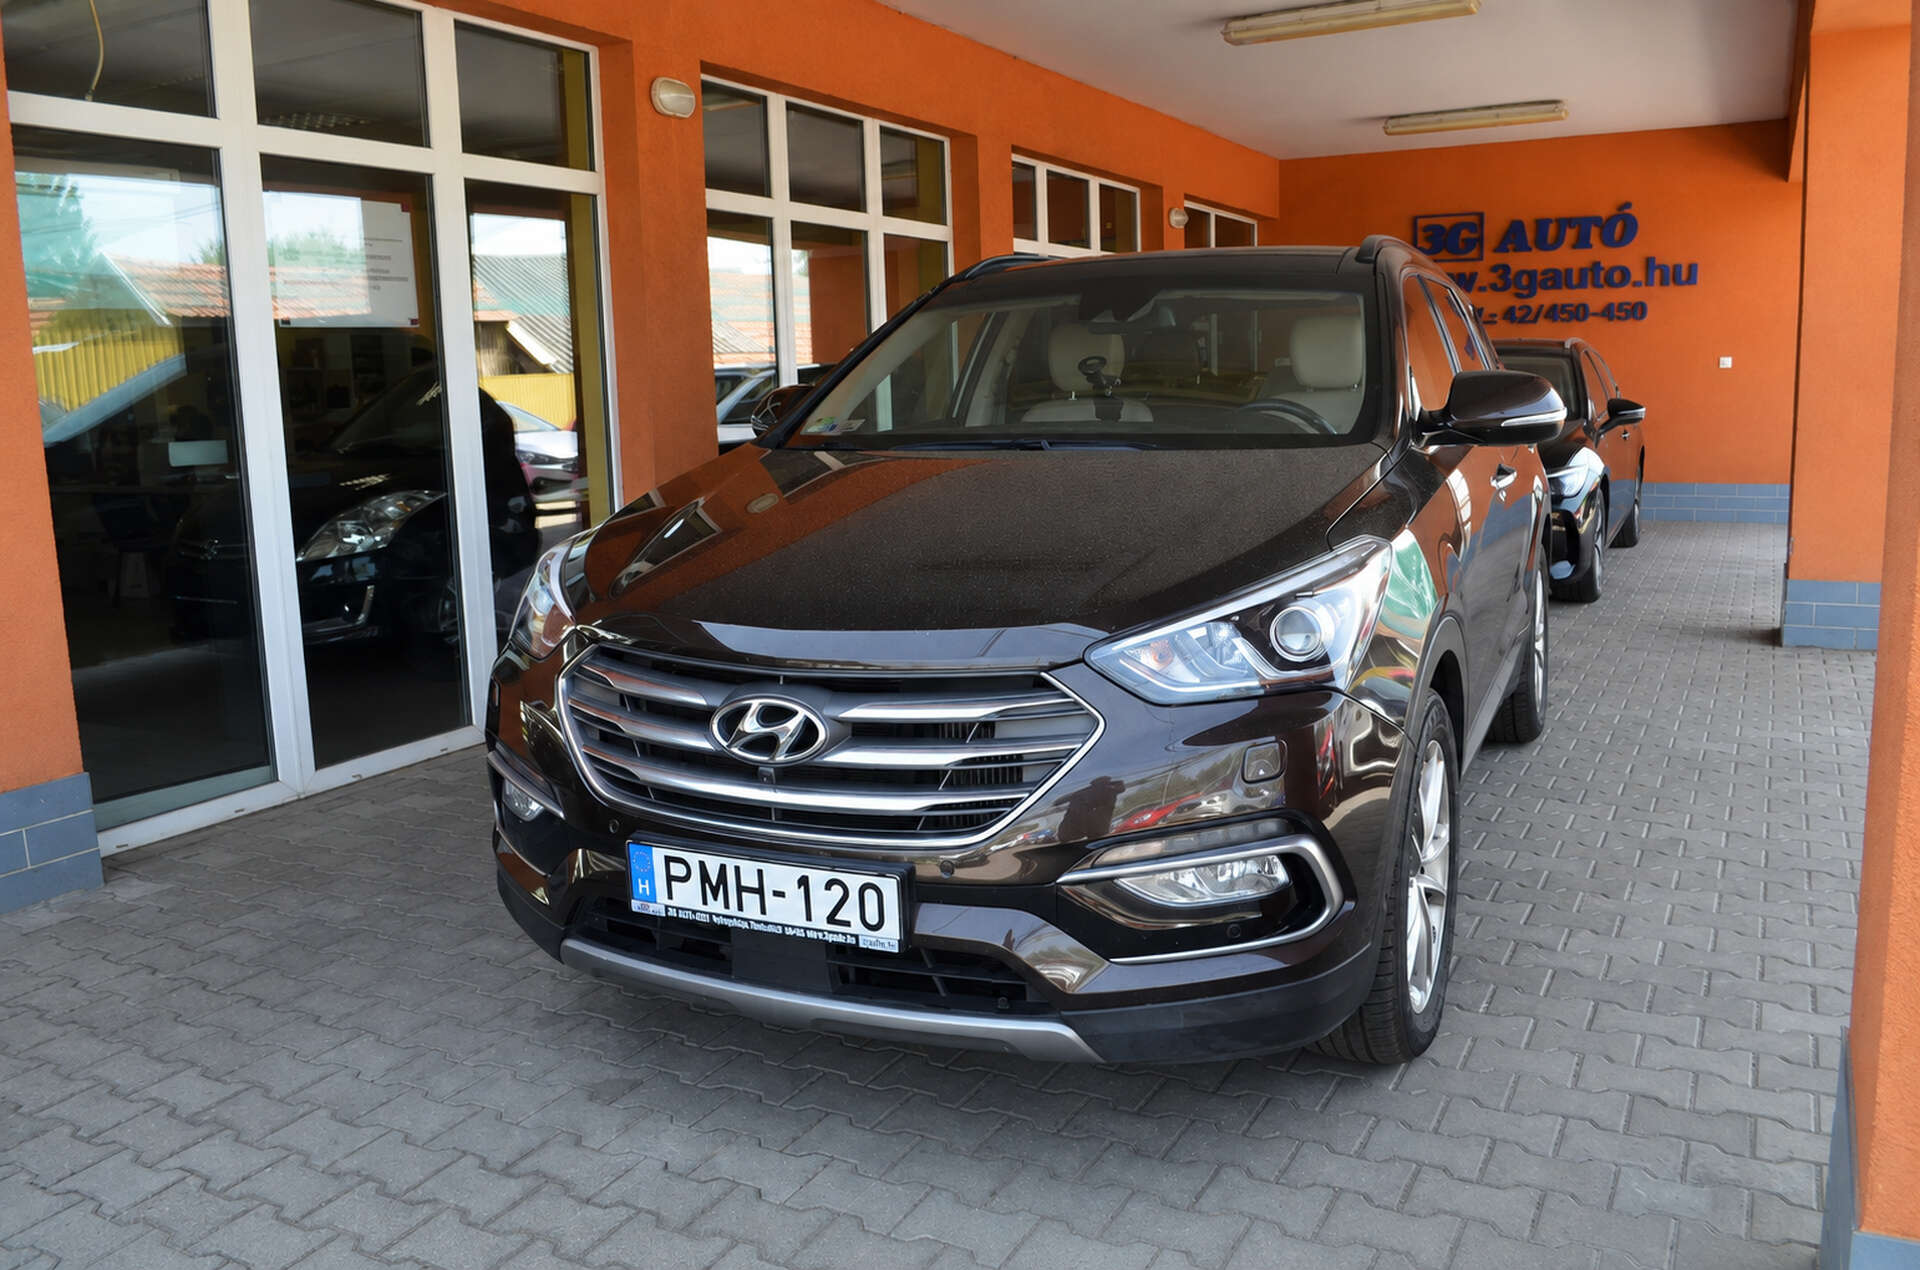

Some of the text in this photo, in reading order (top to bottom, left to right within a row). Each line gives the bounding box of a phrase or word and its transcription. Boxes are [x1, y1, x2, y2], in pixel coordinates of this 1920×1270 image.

[1419, 202, 1638, 255] 3G AUTÓ
[1447, 256, 1698, 299] w.3gauto.hu
[1502, 300, 1648, 324] 42/450-450
[637, 878, 650, 897] H
[664, 855, 885, 931] PMH-120
